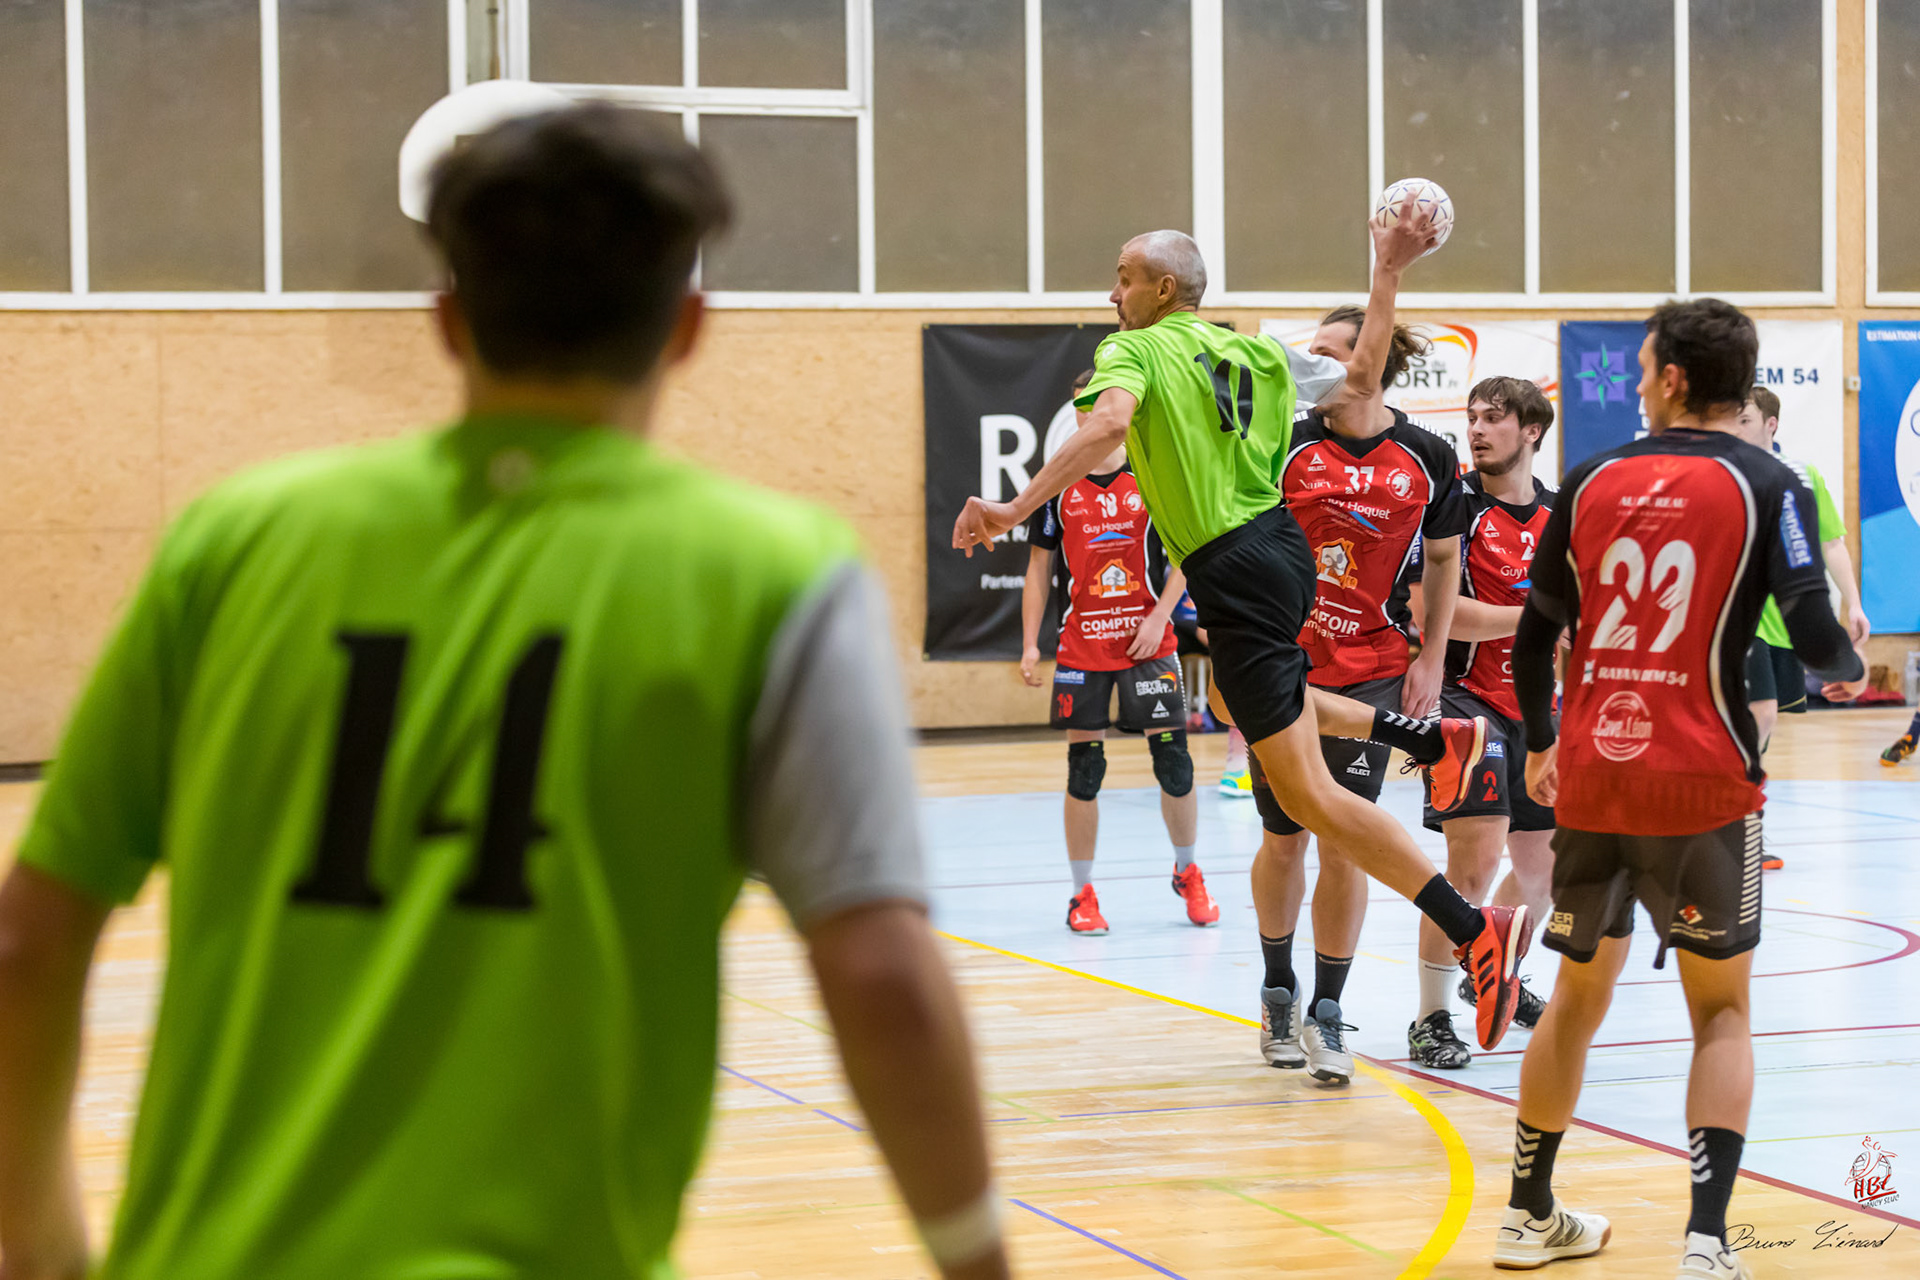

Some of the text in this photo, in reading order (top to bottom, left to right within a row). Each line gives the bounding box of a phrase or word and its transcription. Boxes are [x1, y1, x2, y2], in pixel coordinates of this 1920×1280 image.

[1867, 330, 1916, 342] ESTIMATION
[1793, 367, 1819, 385] 54
[1307, 464, 1327, 472] SELECT
[1344, 465, 1375, 494] 37
[1347, 501, 1391, 520] Hoquet
[1083, 520, 1135, 534] Guy Hoquet
[1500, 565, 1522, 580] Guy
[1590, 536, 1696, 653] 29
[1110, 606, 1121, 615] LE
[1666, 671, 1688, 687] 54
[289, 628, 567, 912] 14
[1346, 766, 1370, 777] SELECT
[1483, 770, 1499, 801] 2
